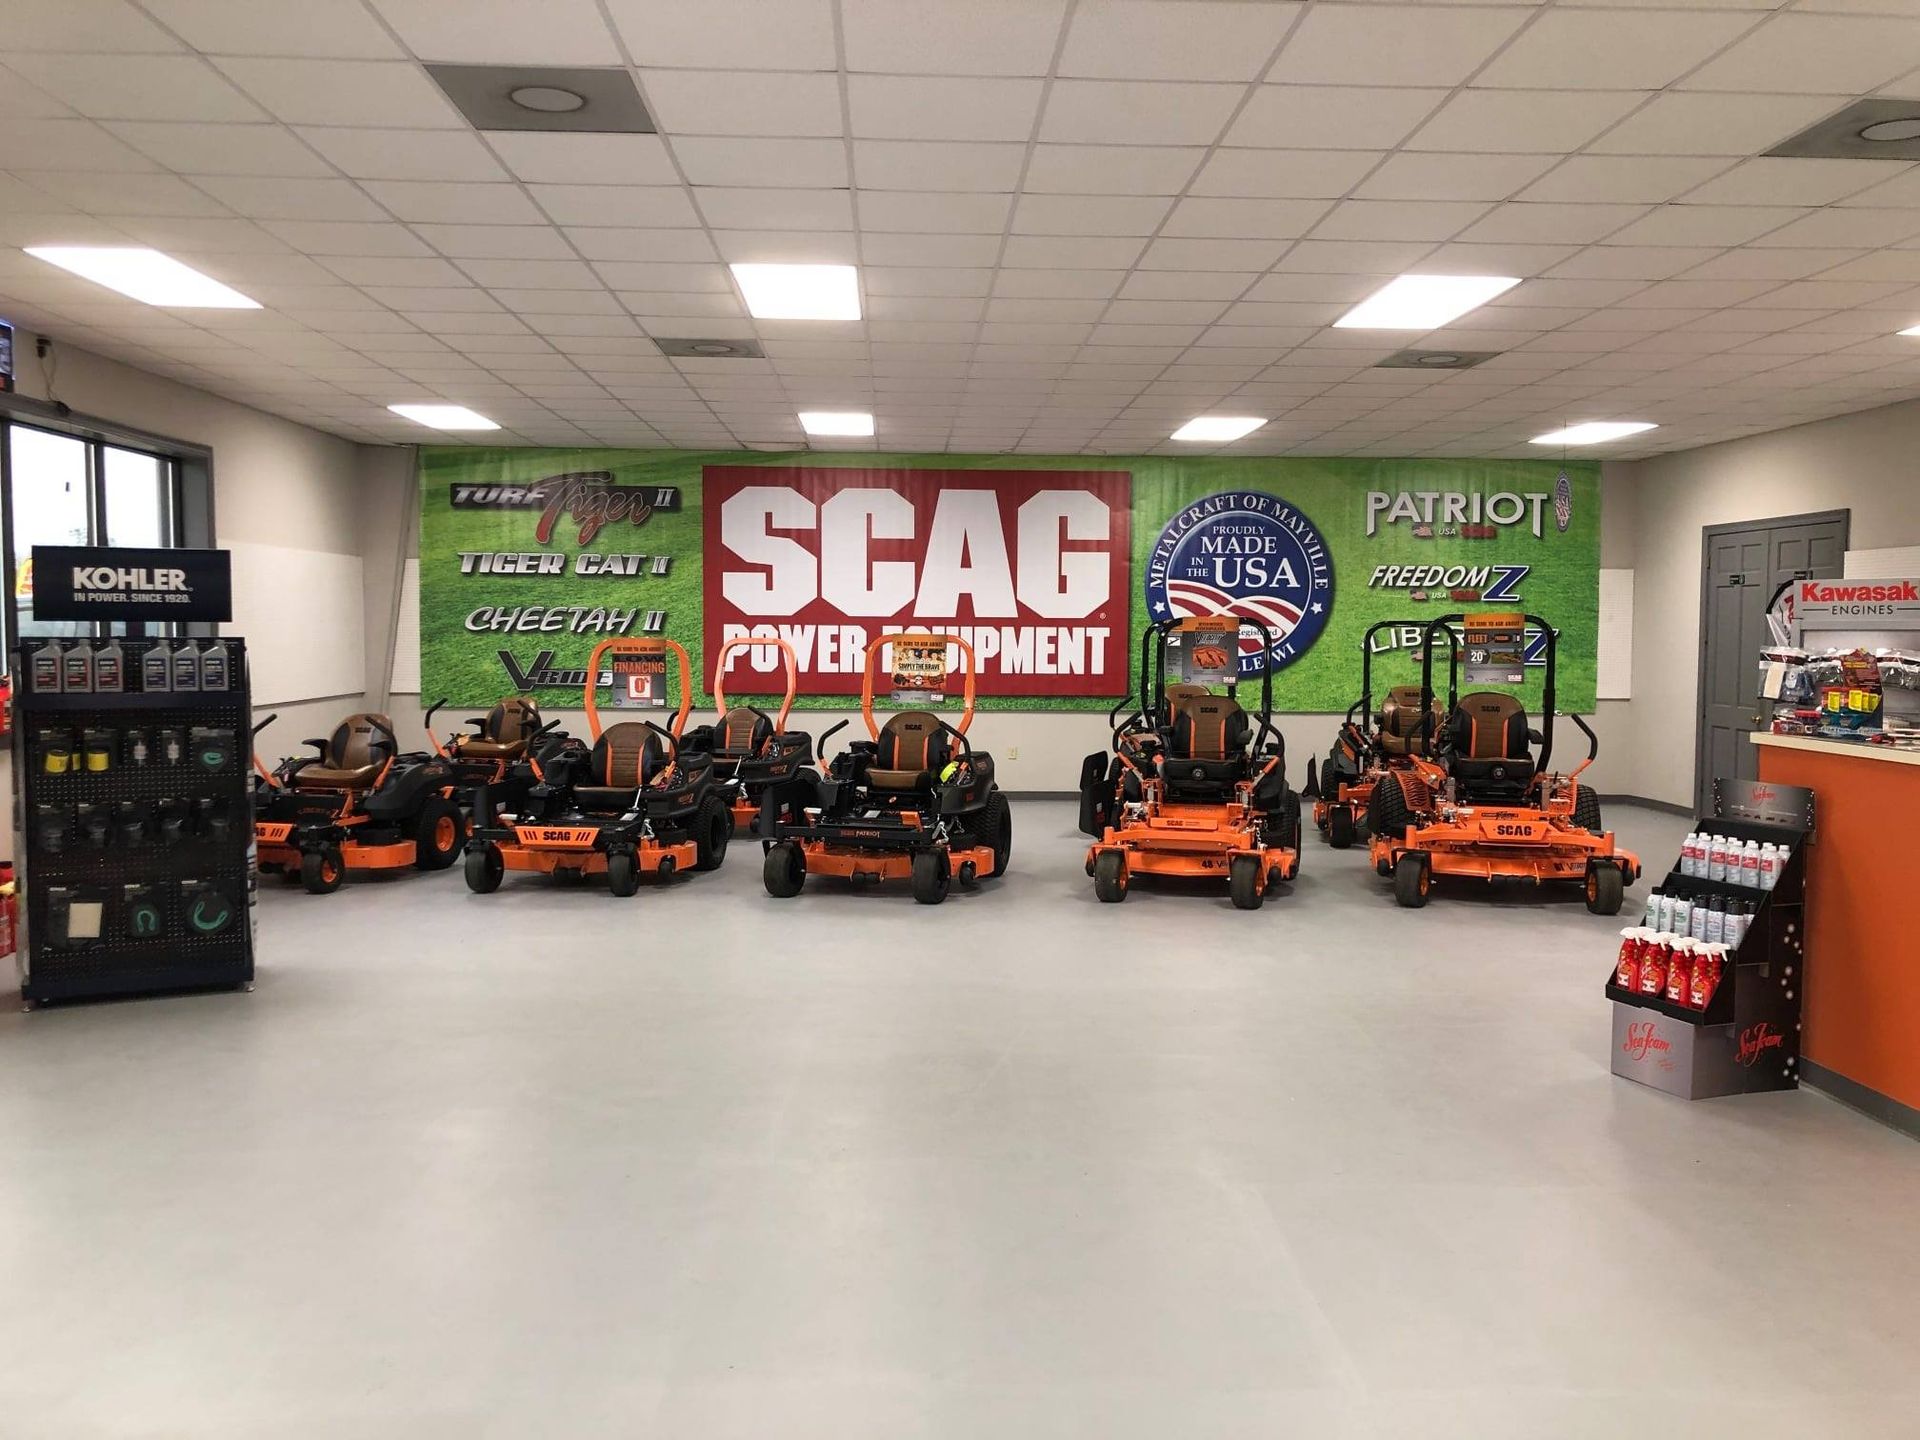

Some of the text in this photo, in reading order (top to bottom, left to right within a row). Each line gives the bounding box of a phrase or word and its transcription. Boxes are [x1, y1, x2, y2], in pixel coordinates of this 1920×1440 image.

[454, 470, 675, 546] TURF Tiger II
[1366, 492, 1548, 538] PATRIOT
[1213, 526, 1266, 535] PROUDLY
[1150, 495, 1329, 590] METALCRAFT OF MAYVILLE
[1200, 536, 1277, 554] MADE
[721, 486, 1110, 619] SCAG
[1191, 557, 1204, 566] IN
[457, 552, 671, 575] TIGER CAT II
[1186, 568, 1208, 577] THE
[1212, 557, 1301, 588] USA
[73, 566, 188, 591] KOHLER
[1368, 565, 1530, 602] FREEDOM Z
[73, 592, 86, 602] IN
[88, 592, 130, 603] POWER.
[131, 593, 163, 603] SINCE
[1802, 581, 1919, 602] Kawasak
[464, 606, 665, 634] CHEETAH II
[1831, 605, 1894, 616] ENGINES
[723, 624, 867, 673] POWER
[1467, 634, 1488, 644] FLEET
[613, 661, 665, 674] FINANCING
[543, 831, 571, 841] SCAG
[1497, 825, 1532, 836] SCAG
[1202, 860, 1213, 869] 48
